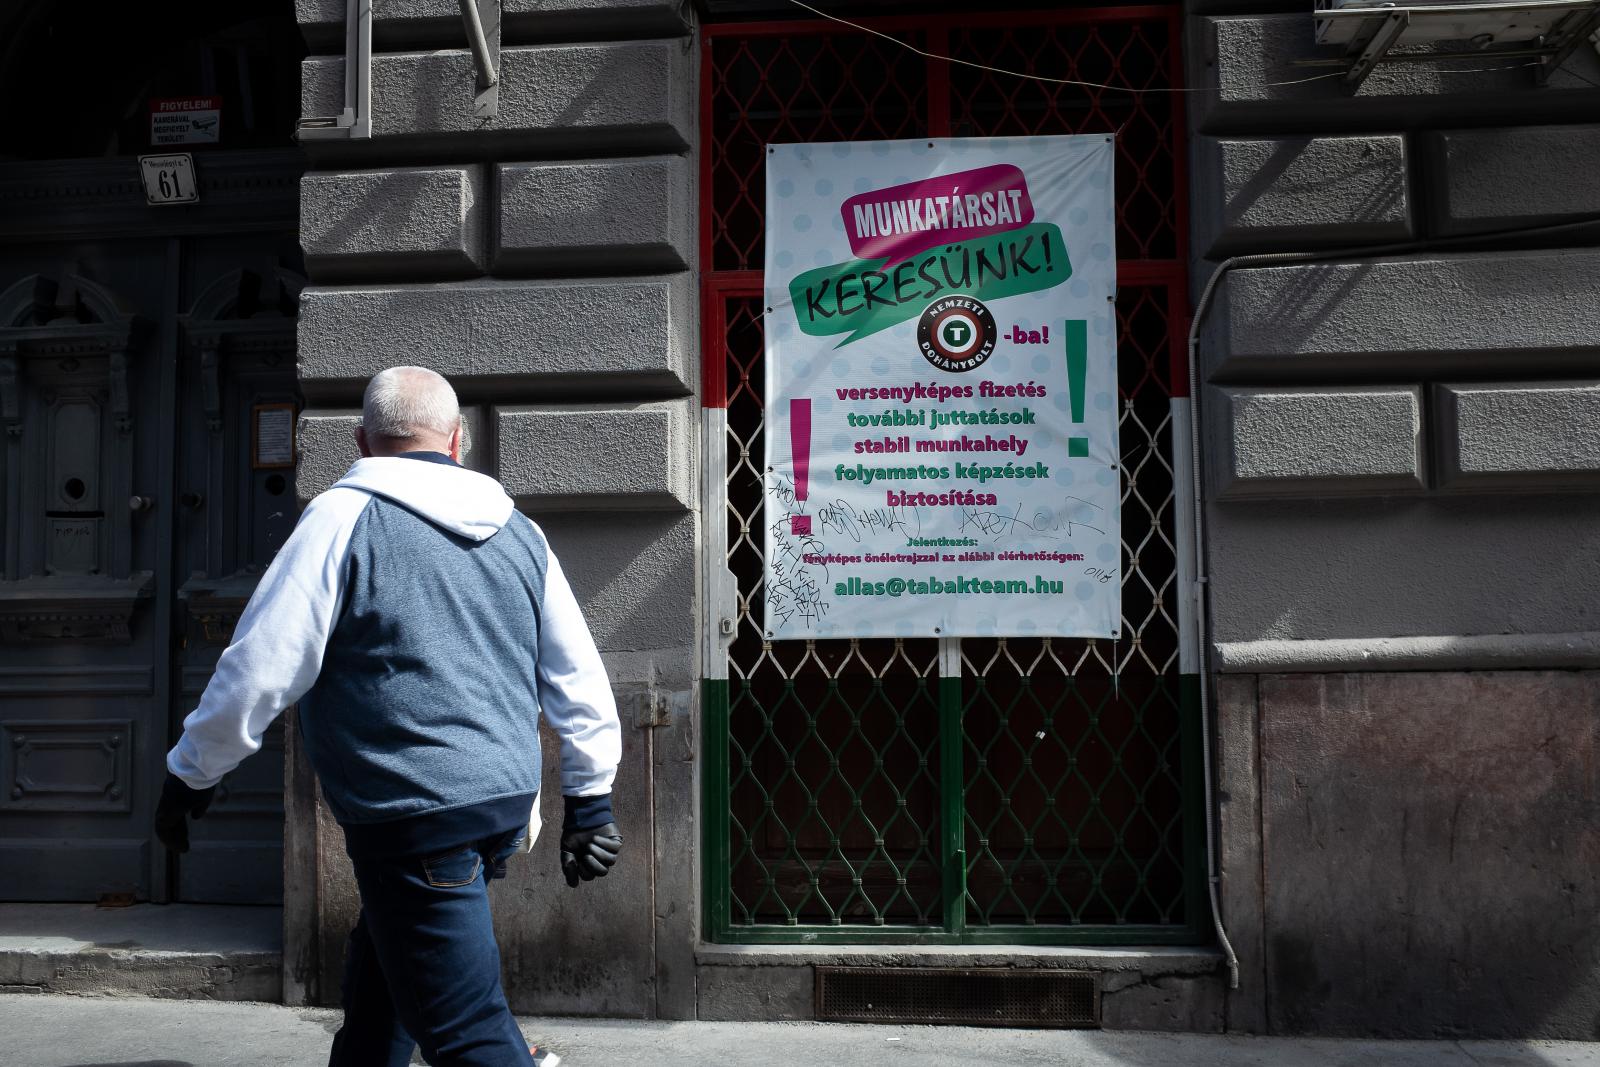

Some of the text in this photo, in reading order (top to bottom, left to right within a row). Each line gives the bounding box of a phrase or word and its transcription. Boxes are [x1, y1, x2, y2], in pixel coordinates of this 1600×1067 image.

[159, 100, 212, 111] FIGYELEM!
[153, 114, 190, 124] KAMERÁVAL
[158, 169, 184, 199] 61
[853, 186, 1023, 239] MUNKATÁRSAT
[805, 231, 1053, 322] KERESÜNK!
[929, 298, 984, 318] NEMZETI
[1003, 325, 1050, 345] -ba!
[921, 340, 994, 370] DOHÁNYBOLT
[836, 382, 1047, 403] versenyképes fizetés
[847, 408, 1036, 430] további juttatások
[854, 435, 1029, 456] stabil munkahely
[834, 463, 1049, 484] folyamatos képzések
[886, 490, 998, 508] biztosítása
[906, 537, 979, 547] Jelentkezés:
[864, 552, 940, 564] önéletrajzzal
[941, 554, 956, 562] az
[957, 552, 995, 562] alábbi
[998, 551, 1085, 563] elérhetőségen:
[834, 574, 1064, 598] allas@tabakteam.hu
